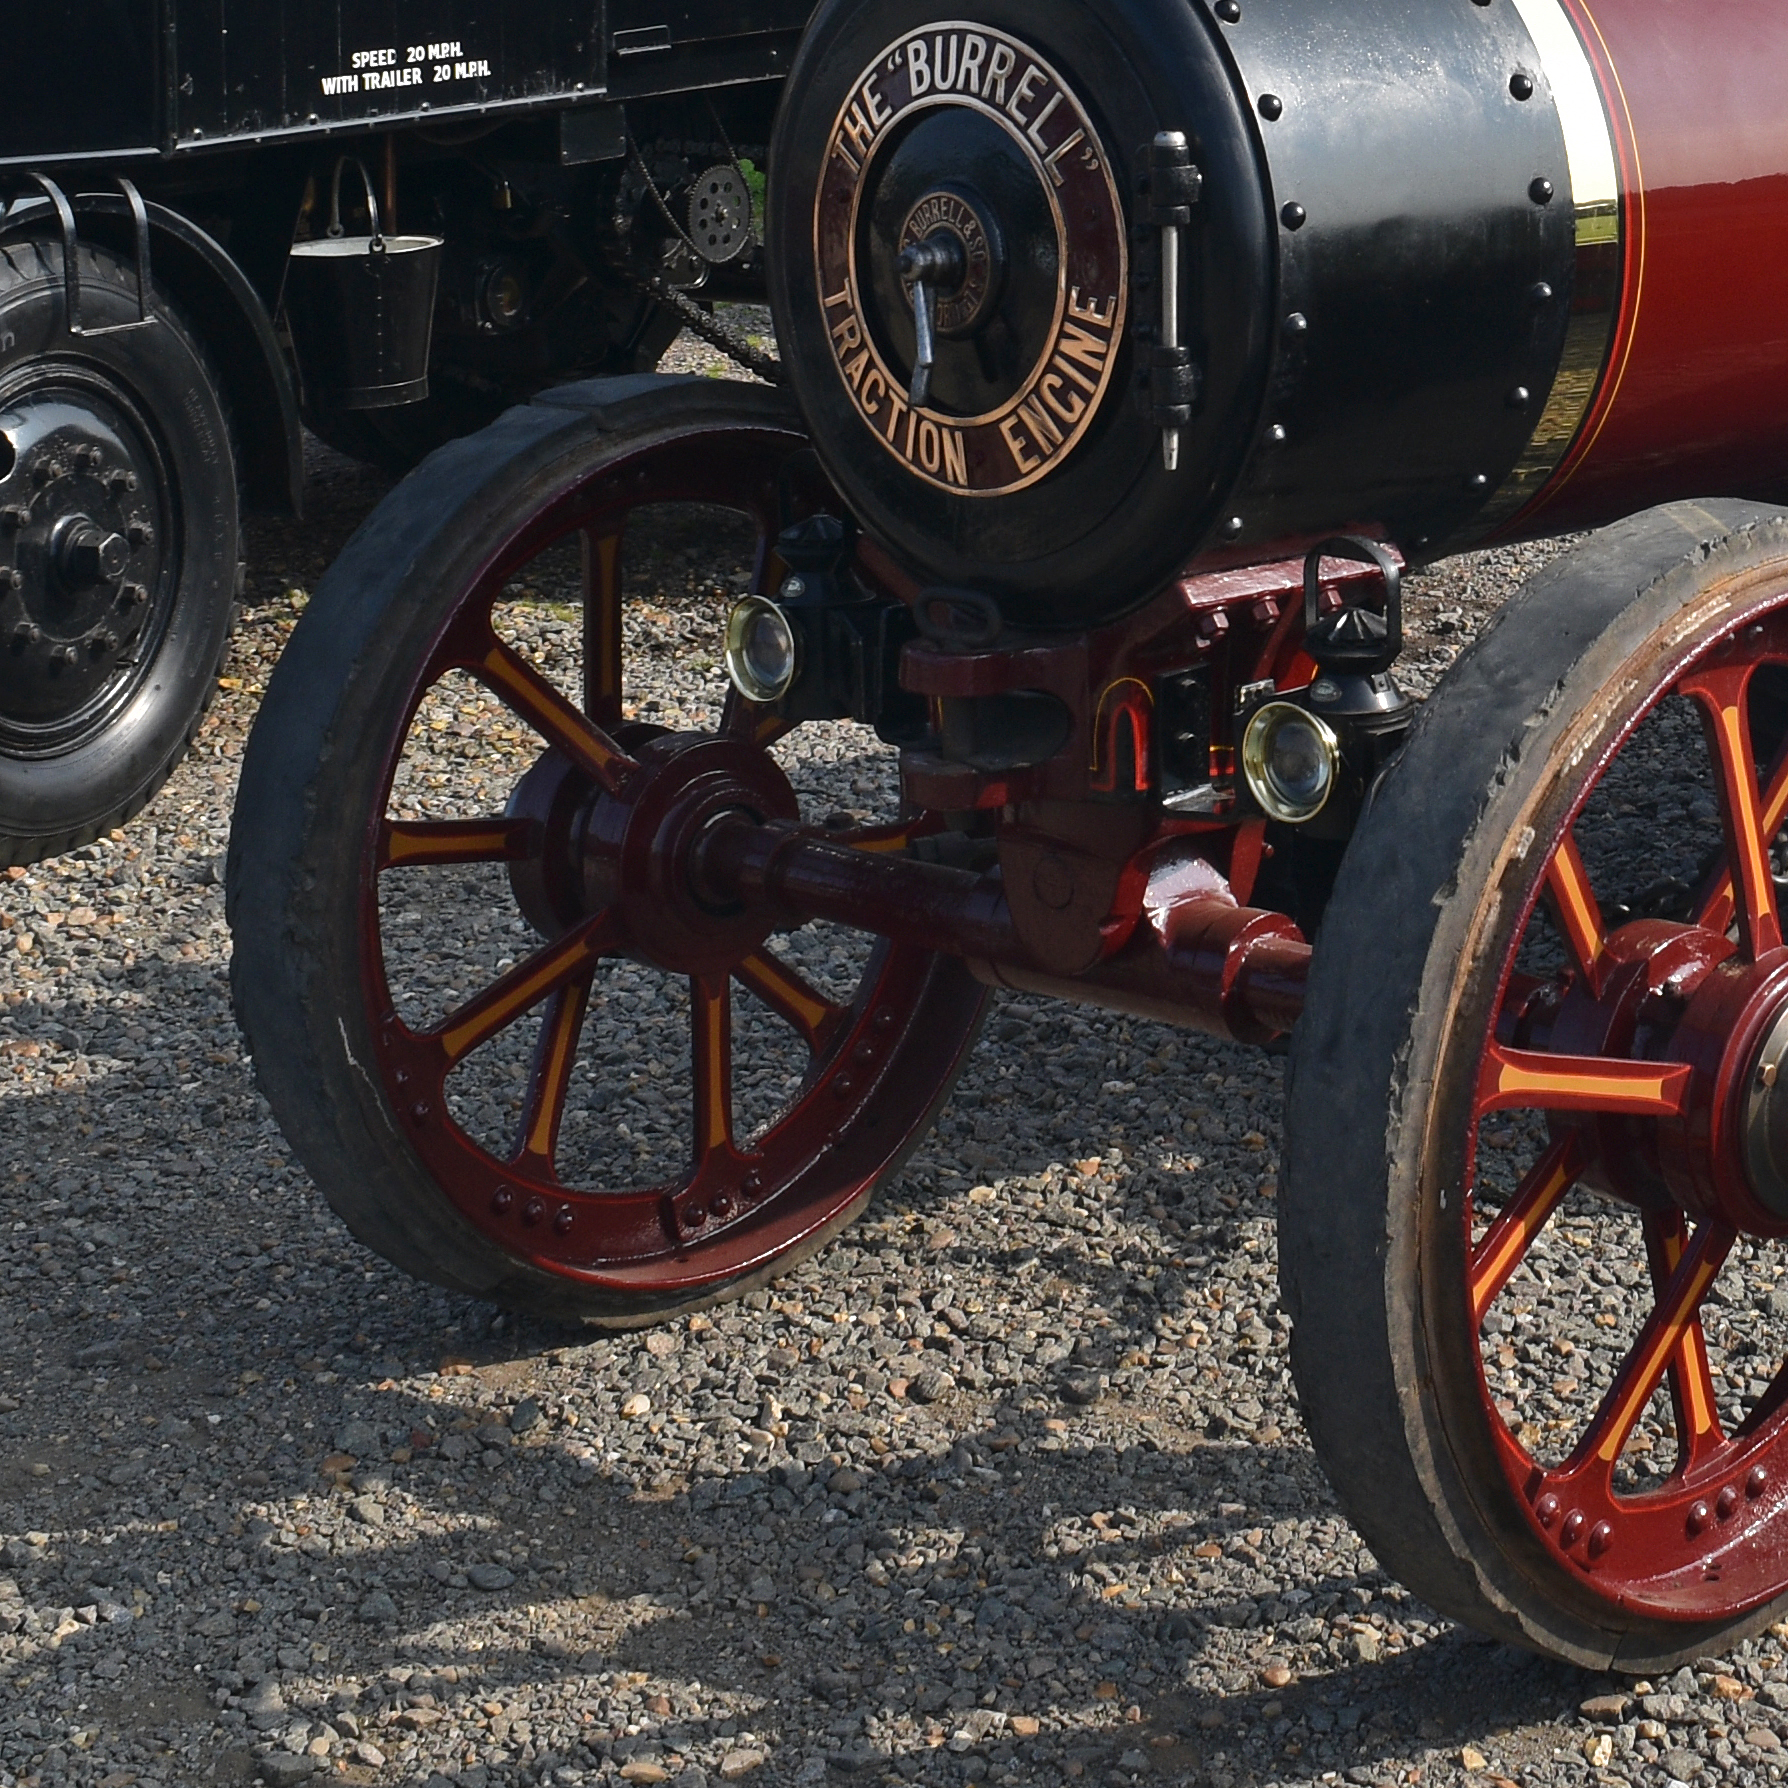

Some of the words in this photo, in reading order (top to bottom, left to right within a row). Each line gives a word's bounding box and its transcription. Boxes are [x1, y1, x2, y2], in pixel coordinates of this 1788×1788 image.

[351, 48, 398, 69] SPEED
[406, 45, 425, 63] 20
[321, 76, 359, 96] WITH
[362, 67, 423, 91] TRAILER
[433, 64, 451, 83] 20
[831, 70, 894, 173] THE
[909, 198, 967, 239] BURRELL
[823, 276, 968, 486] TRACTION
[1002, 285, 1117, 475] ENGINE
